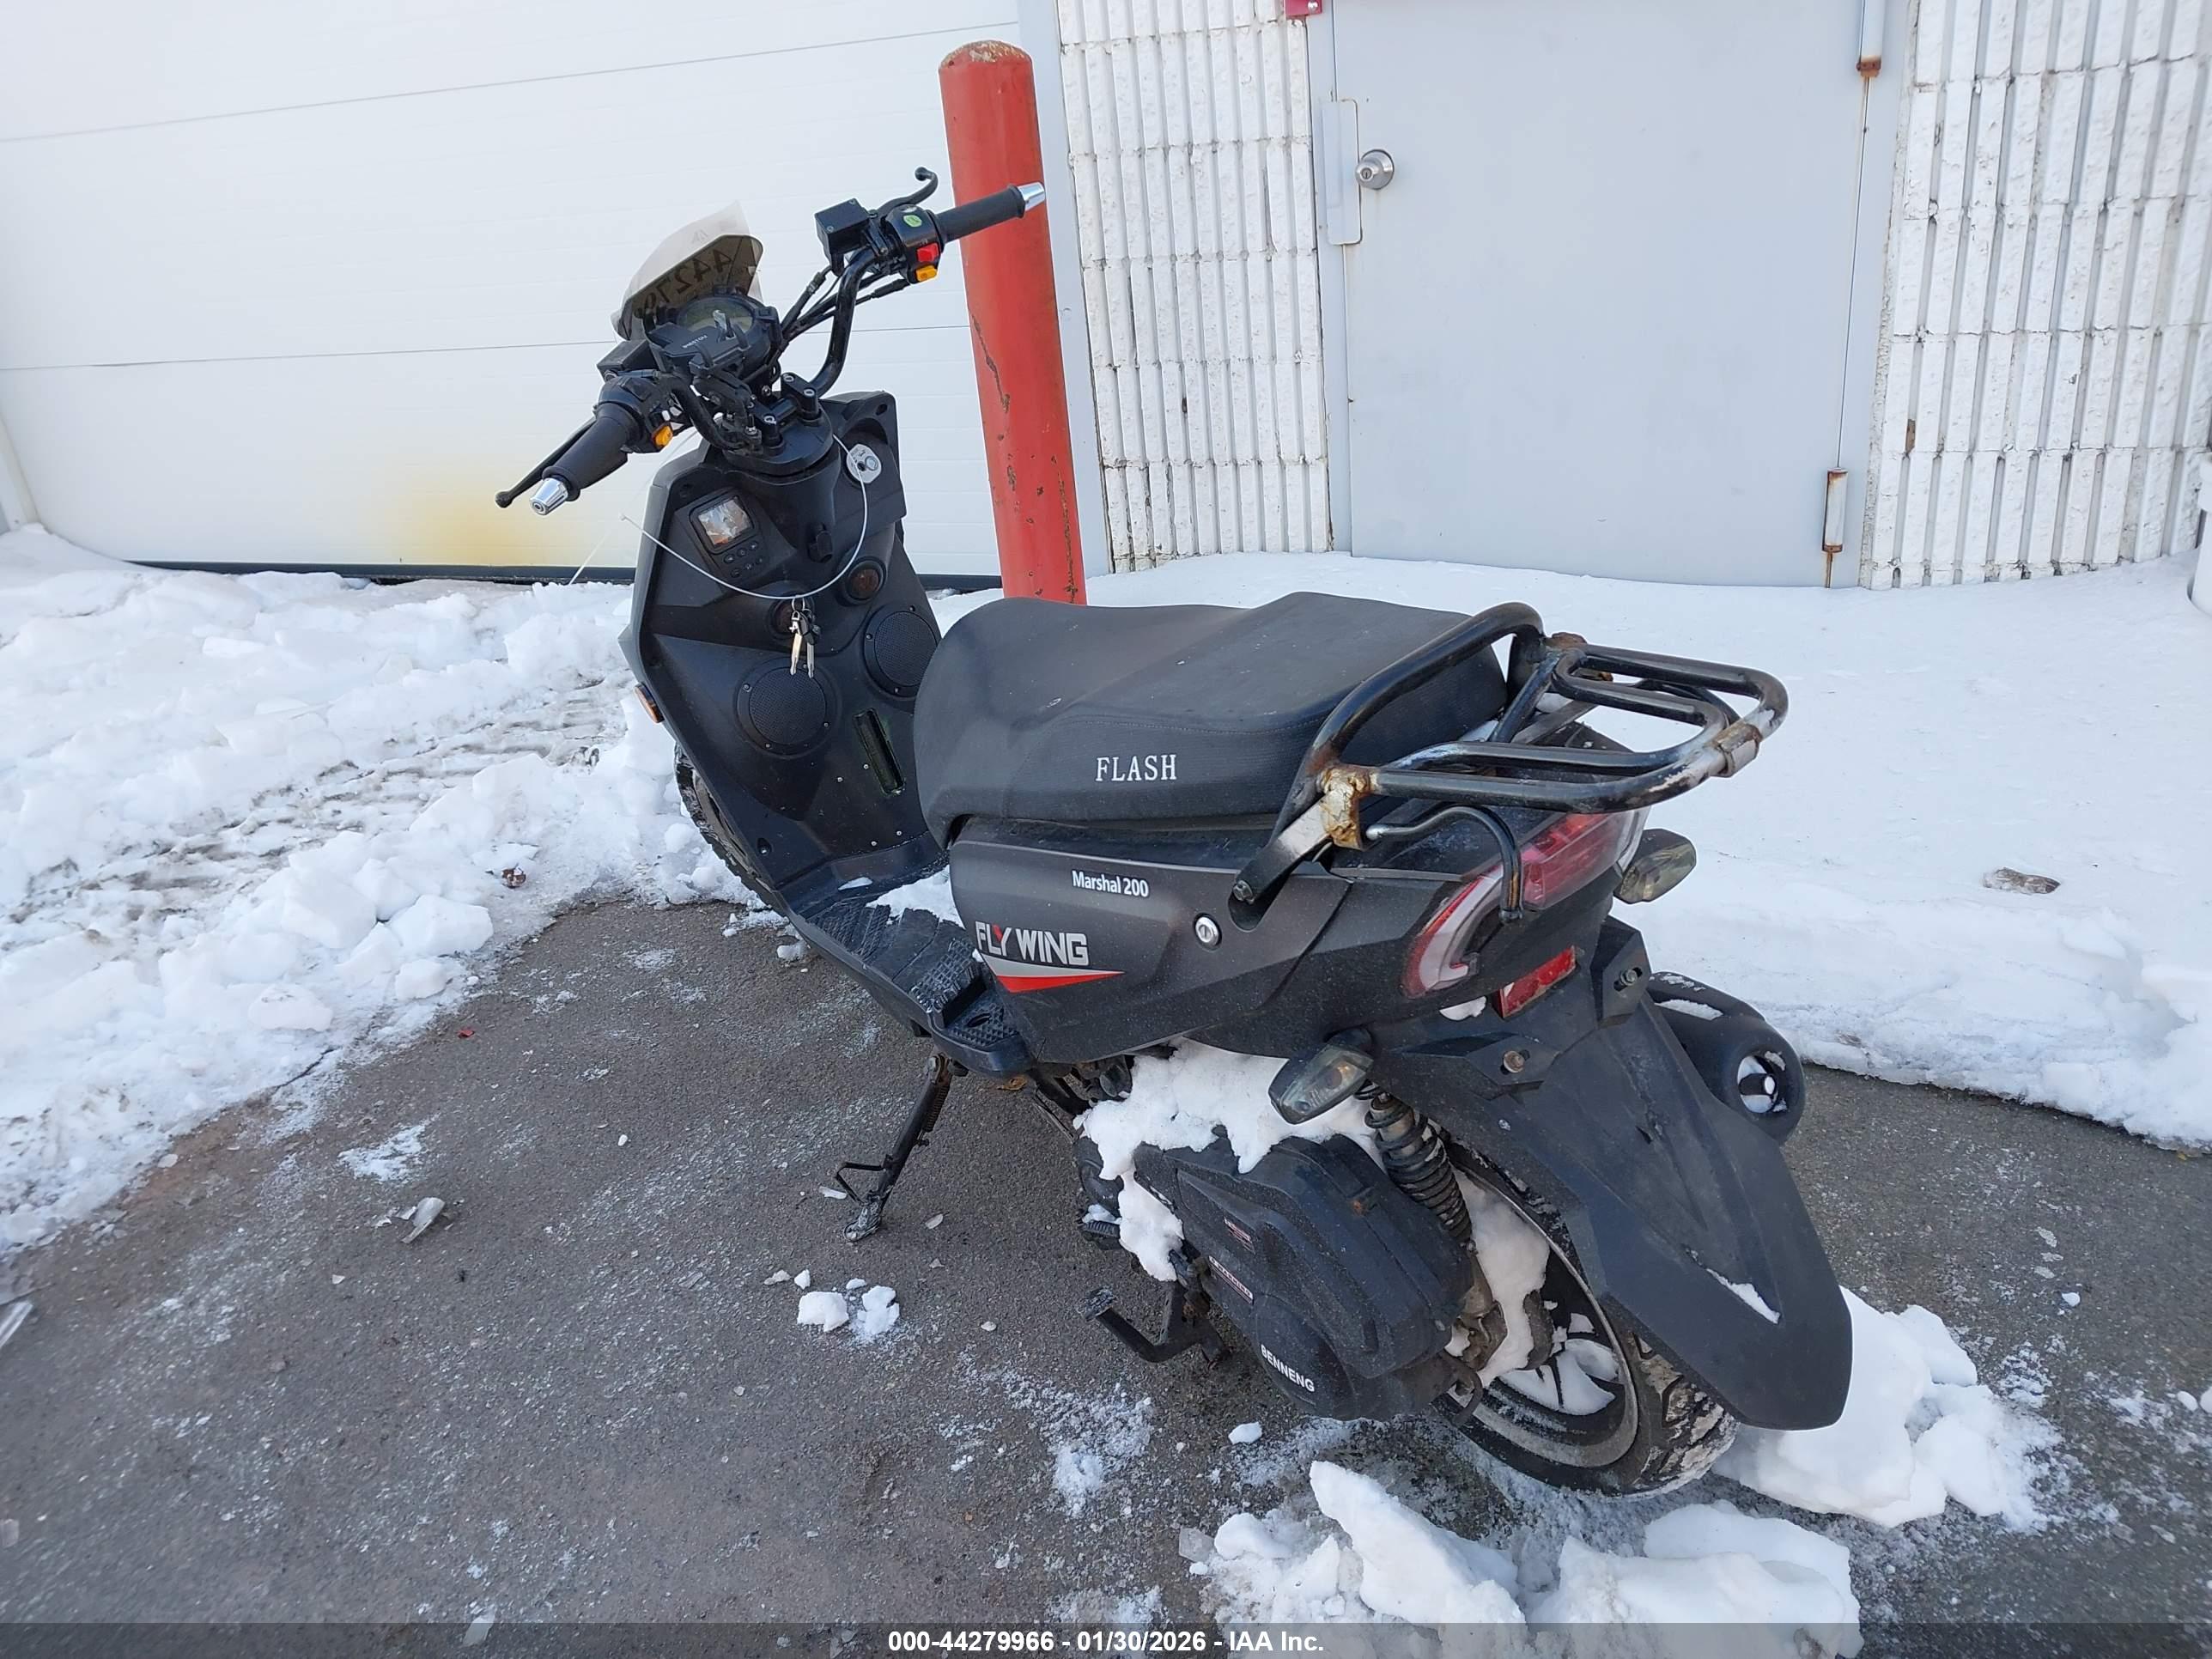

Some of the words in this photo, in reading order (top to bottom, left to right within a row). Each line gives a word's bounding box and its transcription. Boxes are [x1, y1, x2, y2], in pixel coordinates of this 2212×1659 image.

[1095, 754, 1177, 781] FLASH
[1072, 870, 1121, 894] Marshal
[1122, 877, 1150, 897] 200
[975, 921, 1012, 957] FLY
[1015, 928, 1090, 966] WING
[1261, 1344, 1316, 1393] BENNENG
